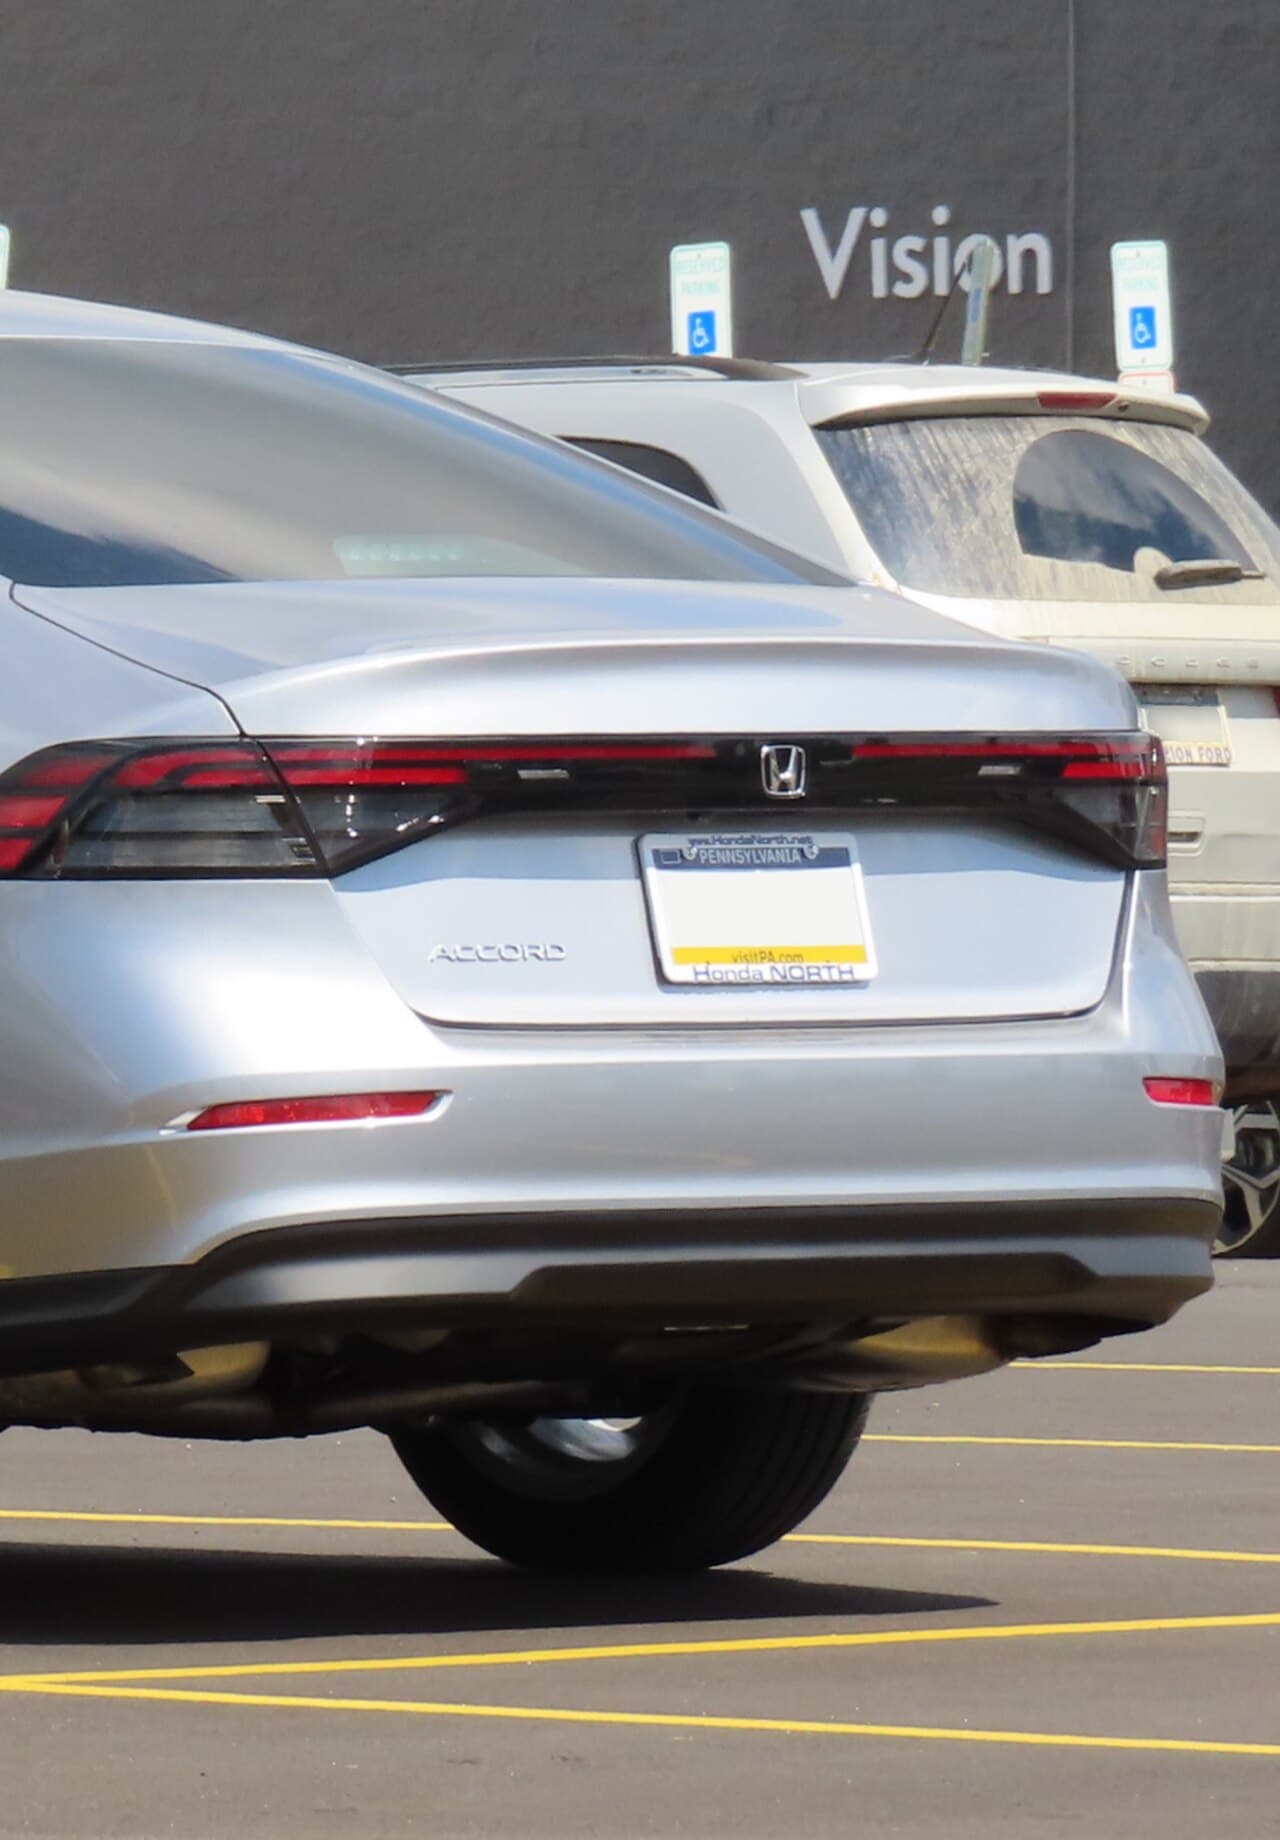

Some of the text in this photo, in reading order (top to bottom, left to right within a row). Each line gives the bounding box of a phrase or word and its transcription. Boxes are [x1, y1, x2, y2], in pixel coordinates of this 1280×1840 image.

[799, 204, 1053, 300] Vision
[1198, 746, 1232, 763] FORD
[699, 848, 803, 865] PENNSYLVANIA
[427, 943, 568, 963] ACCORD
[731, 950, 804, 964] visitPA.com
[692, 964, 855, 982] Honda NORTH
